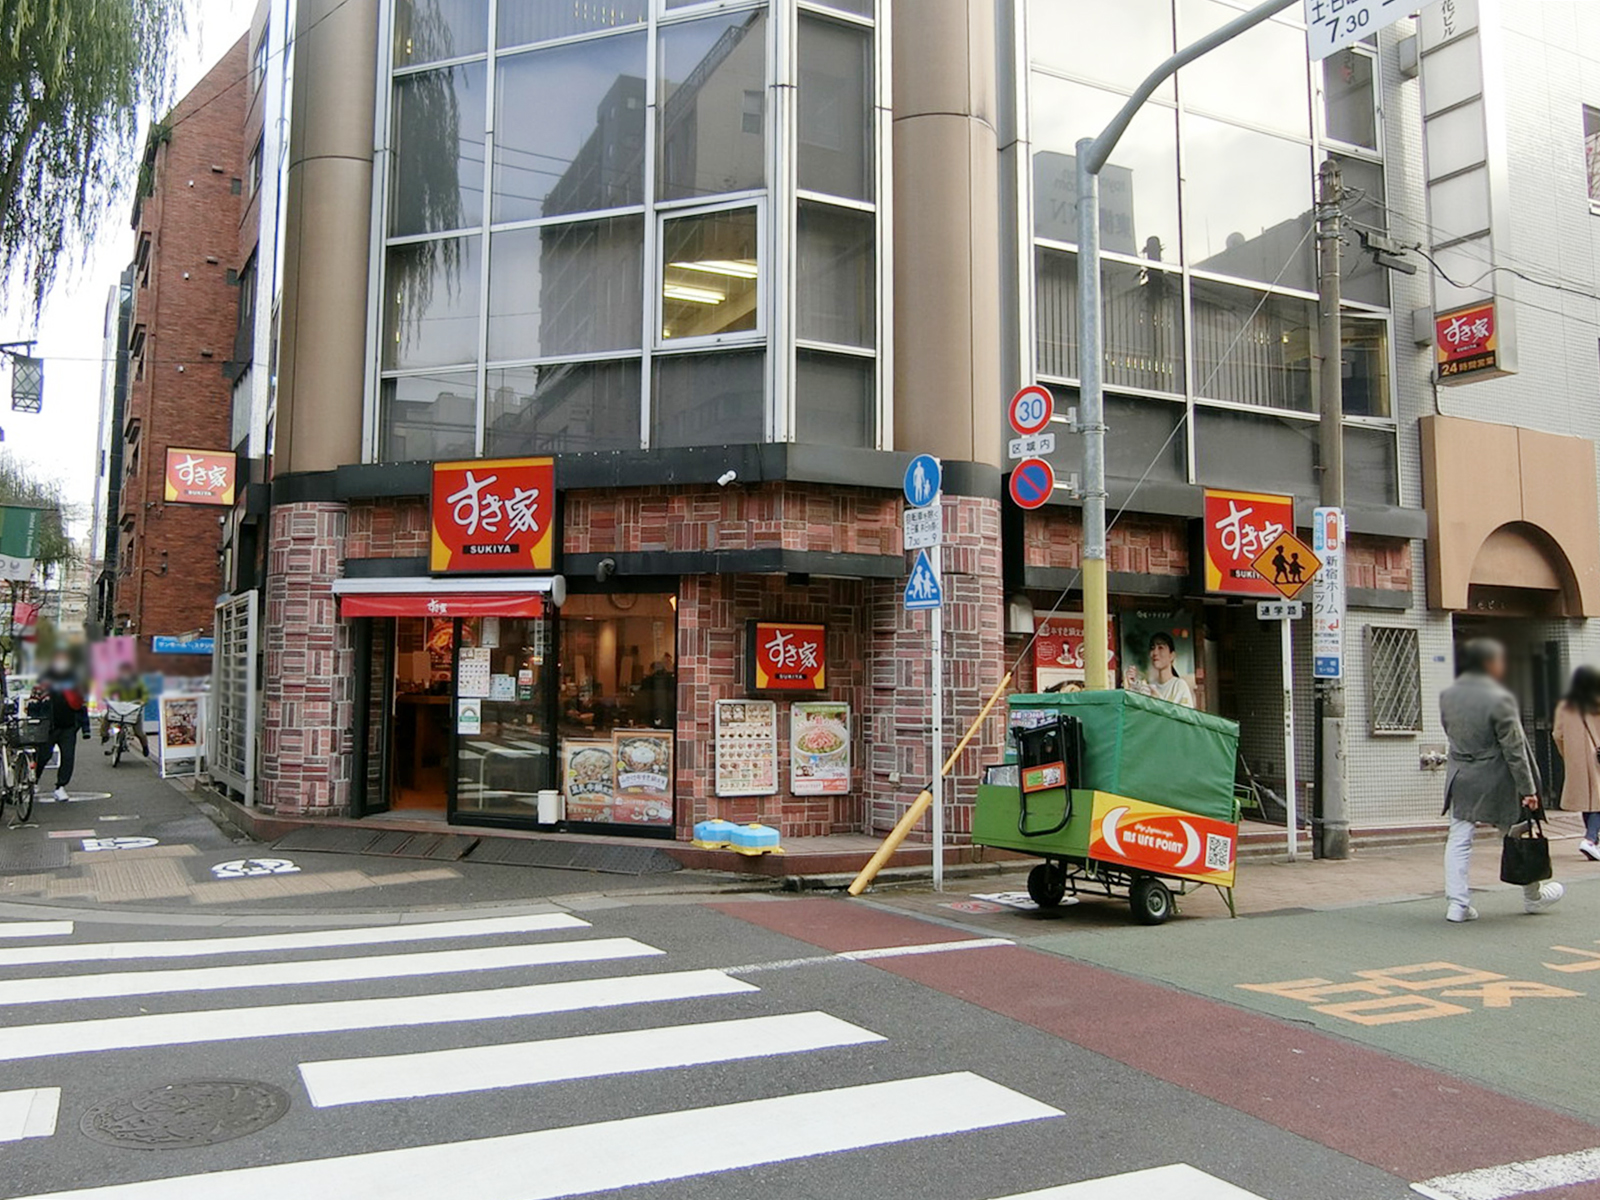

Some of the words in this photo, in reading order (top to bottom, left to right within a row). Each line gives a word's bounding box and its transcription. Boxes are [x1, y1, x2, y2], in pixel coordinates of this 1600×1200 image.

[1325, 8, 1370, 43] 7.30
[1443, 317, 1490, 345] すき家
[1441, 356, 1494, 376] 24時間営業
[1019, 398, 1043, 422] 30
[1012, 439, 1050, 454] 区域内
[174, 454, 228, 490] すき家
[446, 470, 540, 542] すき家
[470, 545, 511, 554] SUKIYA
[1314, 570, 1325, 614] リニック
[1325, 555, 1339, 615] 新宿ホーム
[426, 598, 448, 616] すき家
[1260, 605, 1297, 616] 通学路
[765, 629, 819, 673] すき家
[1123, 830, 1136, 843] MS
[1137, 833, 1154, 848] LIFE
[1155, 837, 1184, 855] POINT
